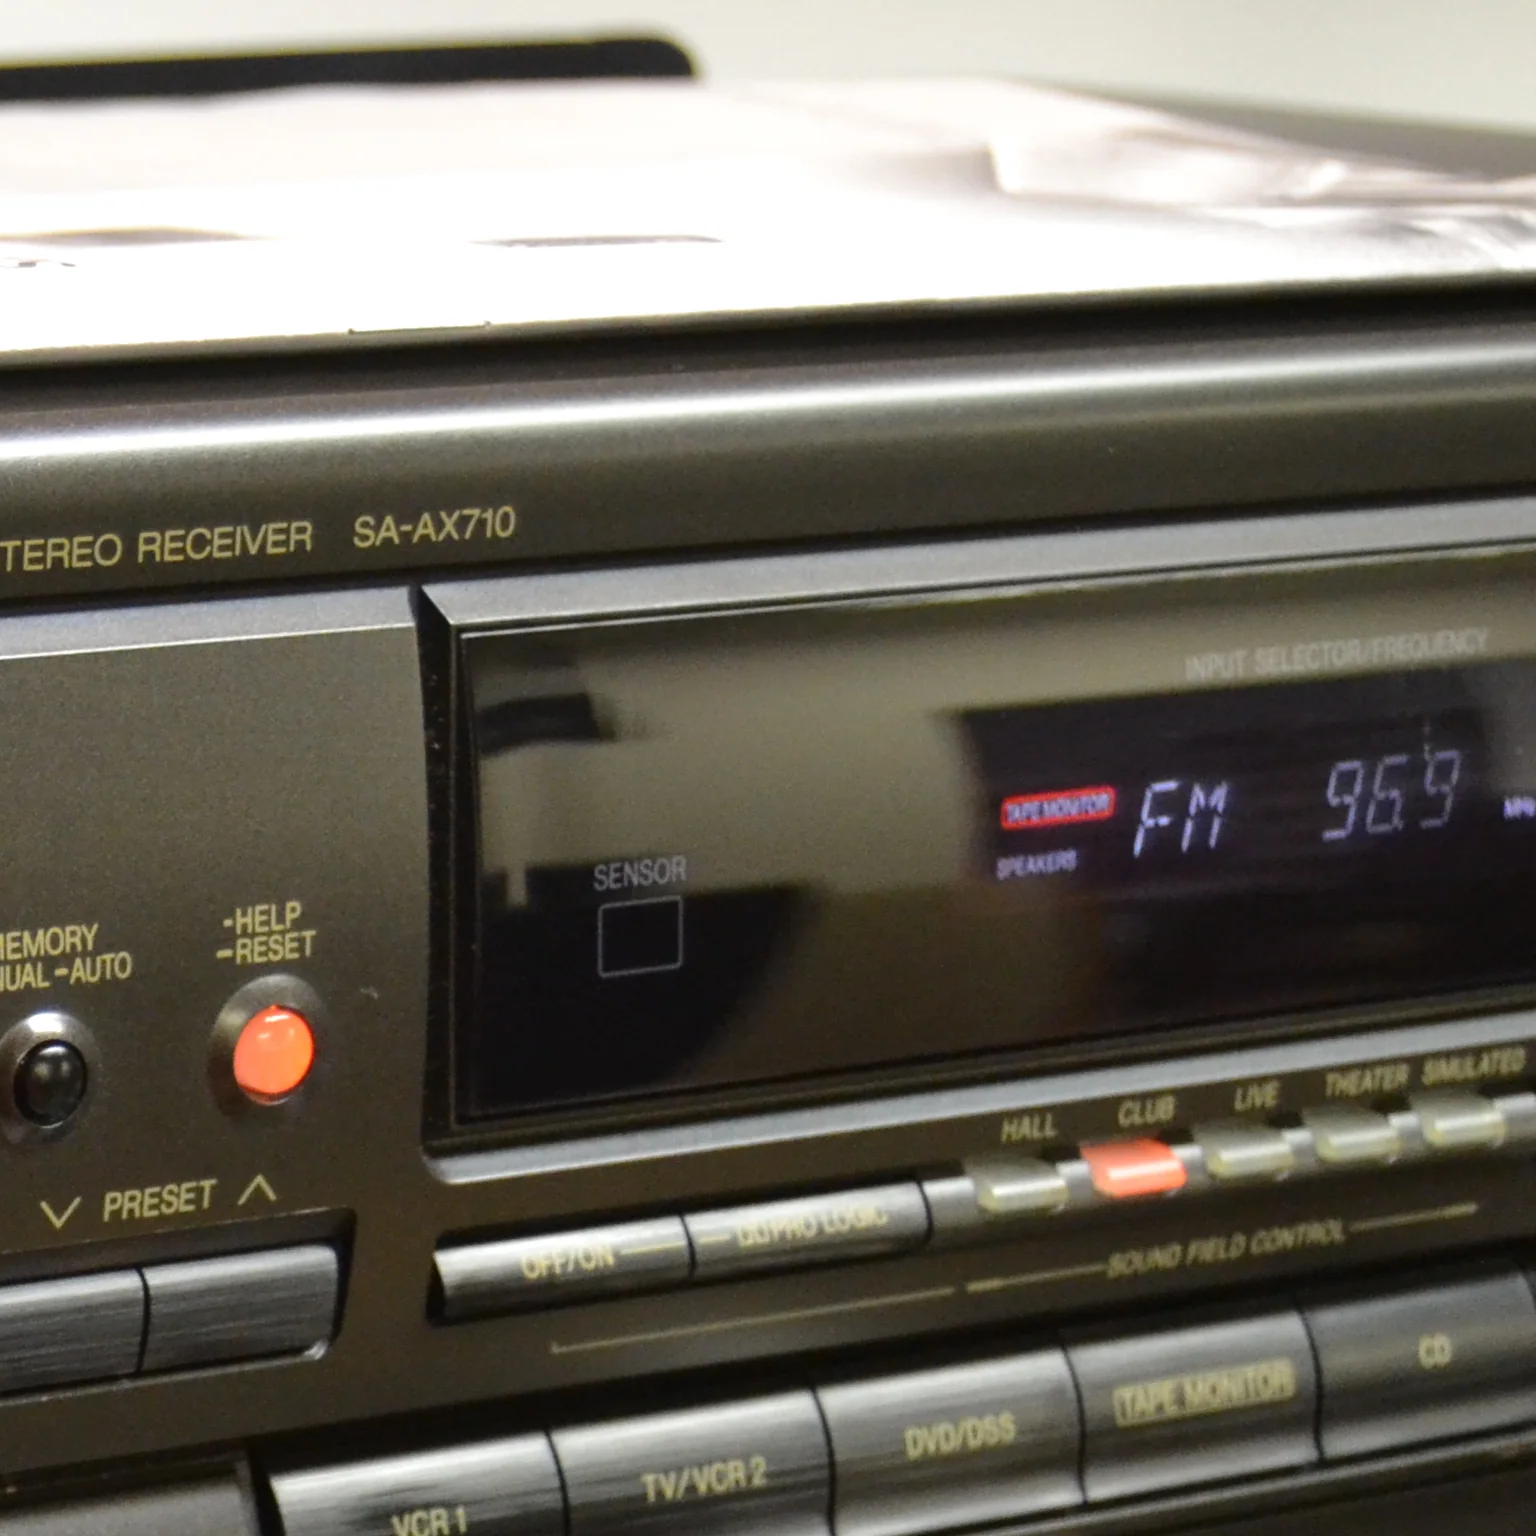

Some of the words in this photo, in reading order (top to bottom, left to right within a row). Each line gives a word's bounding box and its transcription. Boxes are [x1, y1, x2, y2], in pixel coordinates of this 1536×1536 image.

[136, 521, 314, 564] RECEIVER
[352, 505, 517, 549] SA-AX710
[1132, 779, 1231, 858] FM
[592, 854, 688, 892] SENSOR
[1233, 1080, 1282, 1113] LIVE
[1325, 1062, 1412, 1098] THEATER
[999, 1112, 1059, 1143] HALL
[1117, 1094, 1178, 1129] CLUB
[103, 1178, 218, 1223] PRESET
[519, 1242, 618, 1282] OFF/ON
[1106, 1239, 1184, 1280] SOUND
[1185, 1230, 1247, 1266] FIELD
[1248, 1217, 1350, 1256] CONTROL
[1418, 1333, 1454, 1370] CD
[1123, 1377, 1182, 1424] TAPE
[1186, 1360, 1294, 1413] MONITOR
[903, 1411, 1018, 1462] DVD/DSS
